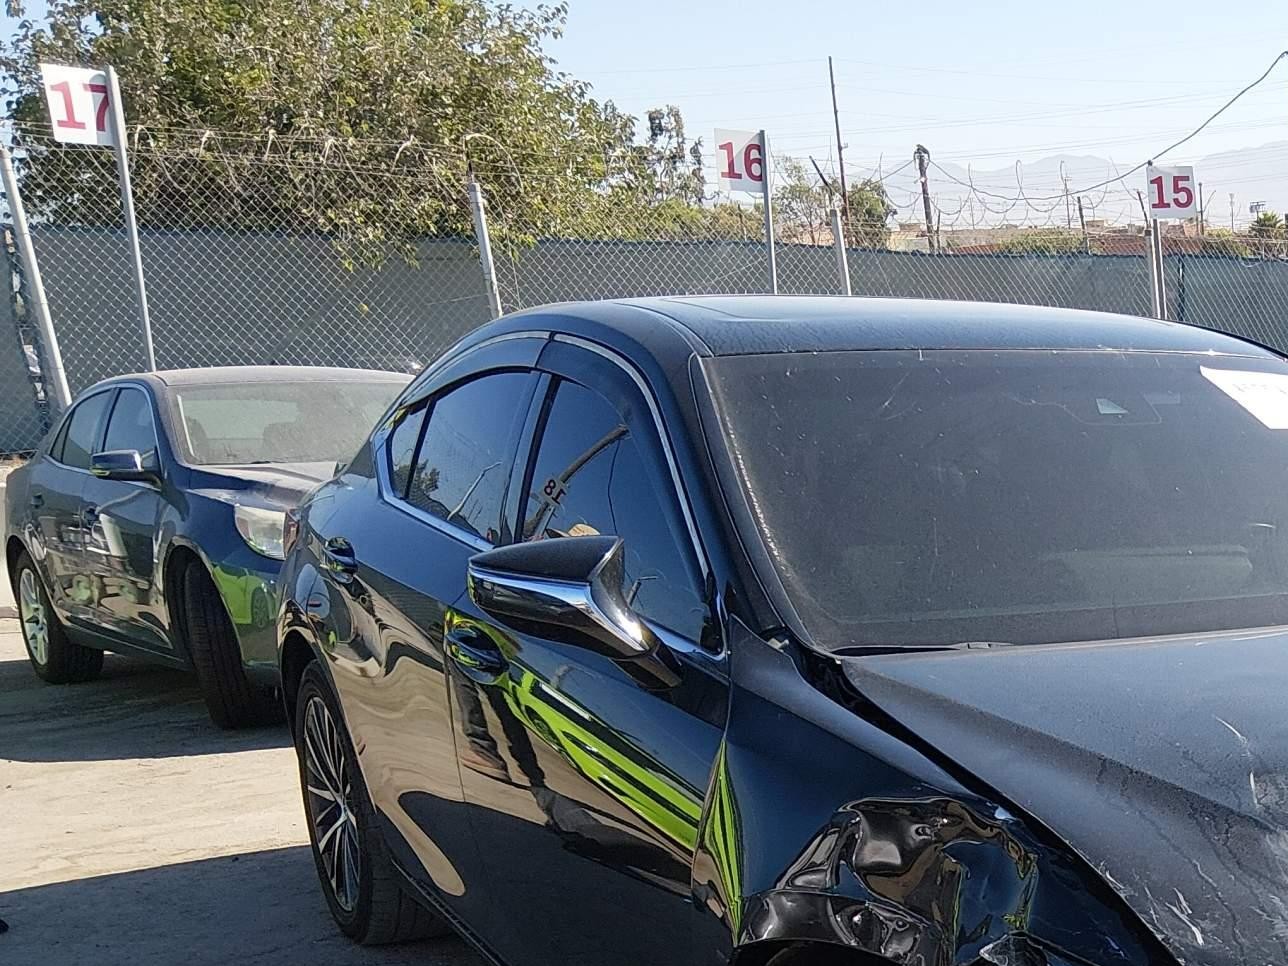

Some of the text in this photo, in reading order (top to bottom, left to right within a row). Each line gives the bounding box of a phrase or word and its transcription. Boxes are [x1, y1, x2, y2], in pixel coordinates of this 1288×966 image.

[49, 80, 110, 133] 17
[718, 142, 763, 182] 16
[1149, 175, 1193, 209] 15
